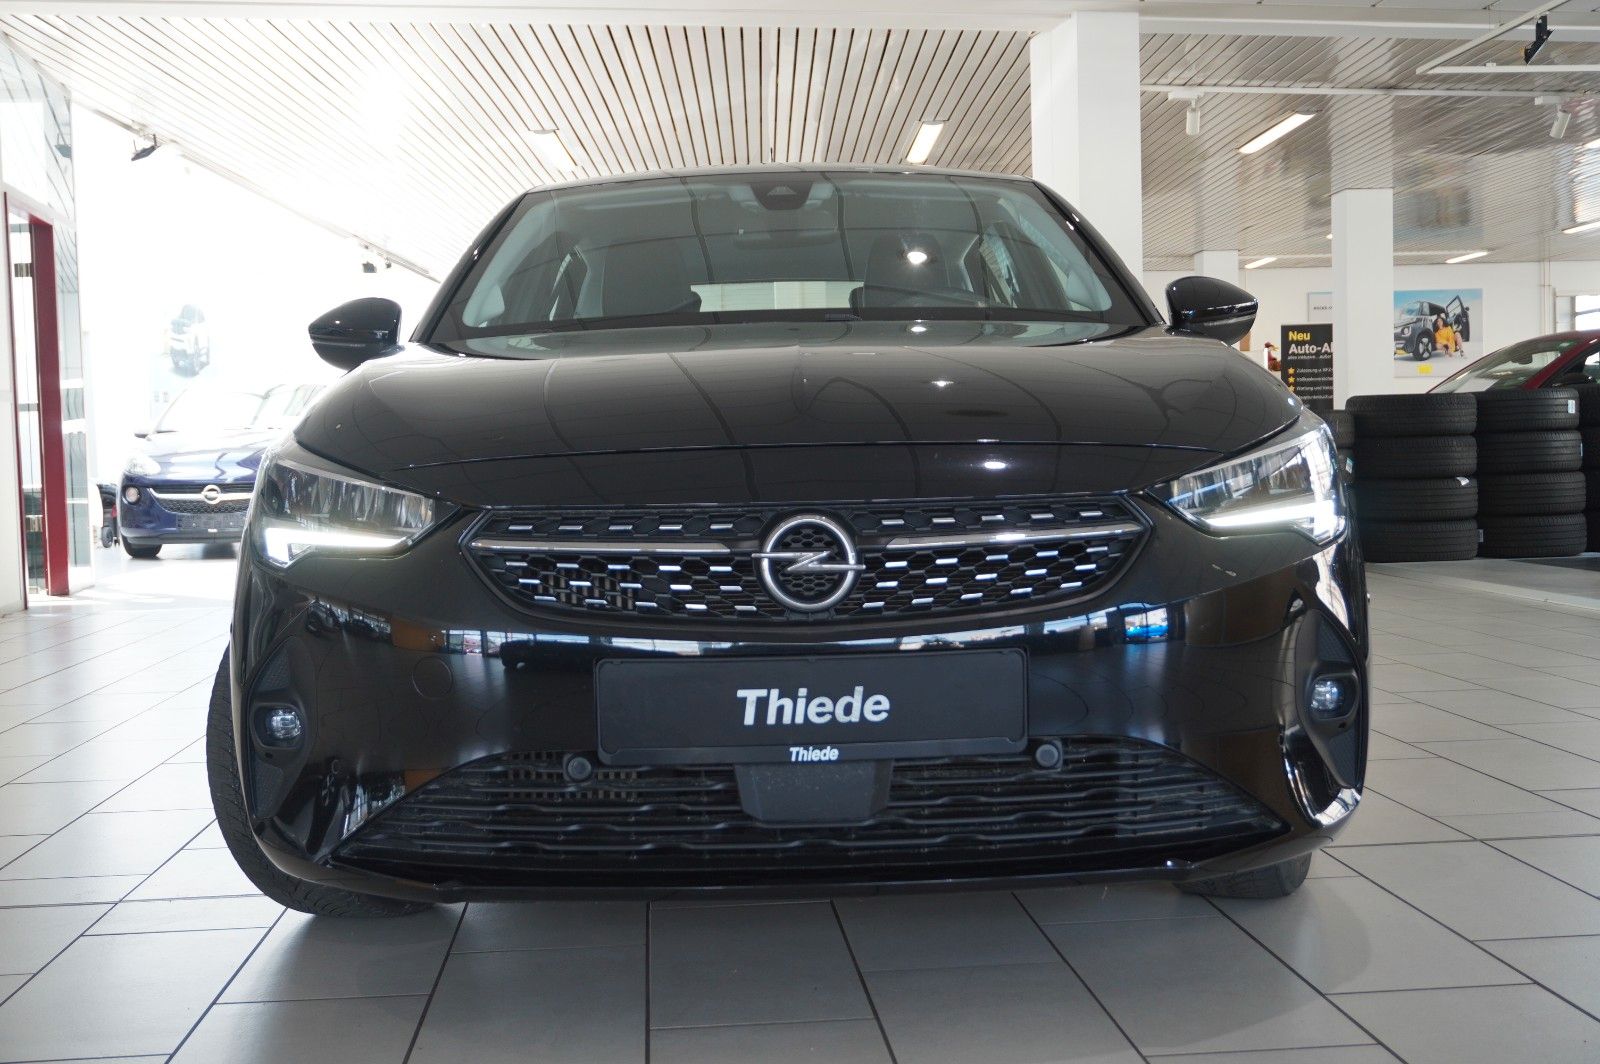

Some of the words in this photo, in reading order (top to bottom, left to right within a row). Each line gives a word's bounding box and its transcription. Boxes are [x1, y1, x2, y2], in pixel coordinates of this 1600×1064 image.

[1288, 331, 1311, 341] Neu
[736, 685, 891, 726] Thiede
[789, 745, 840, 762] Thiede
